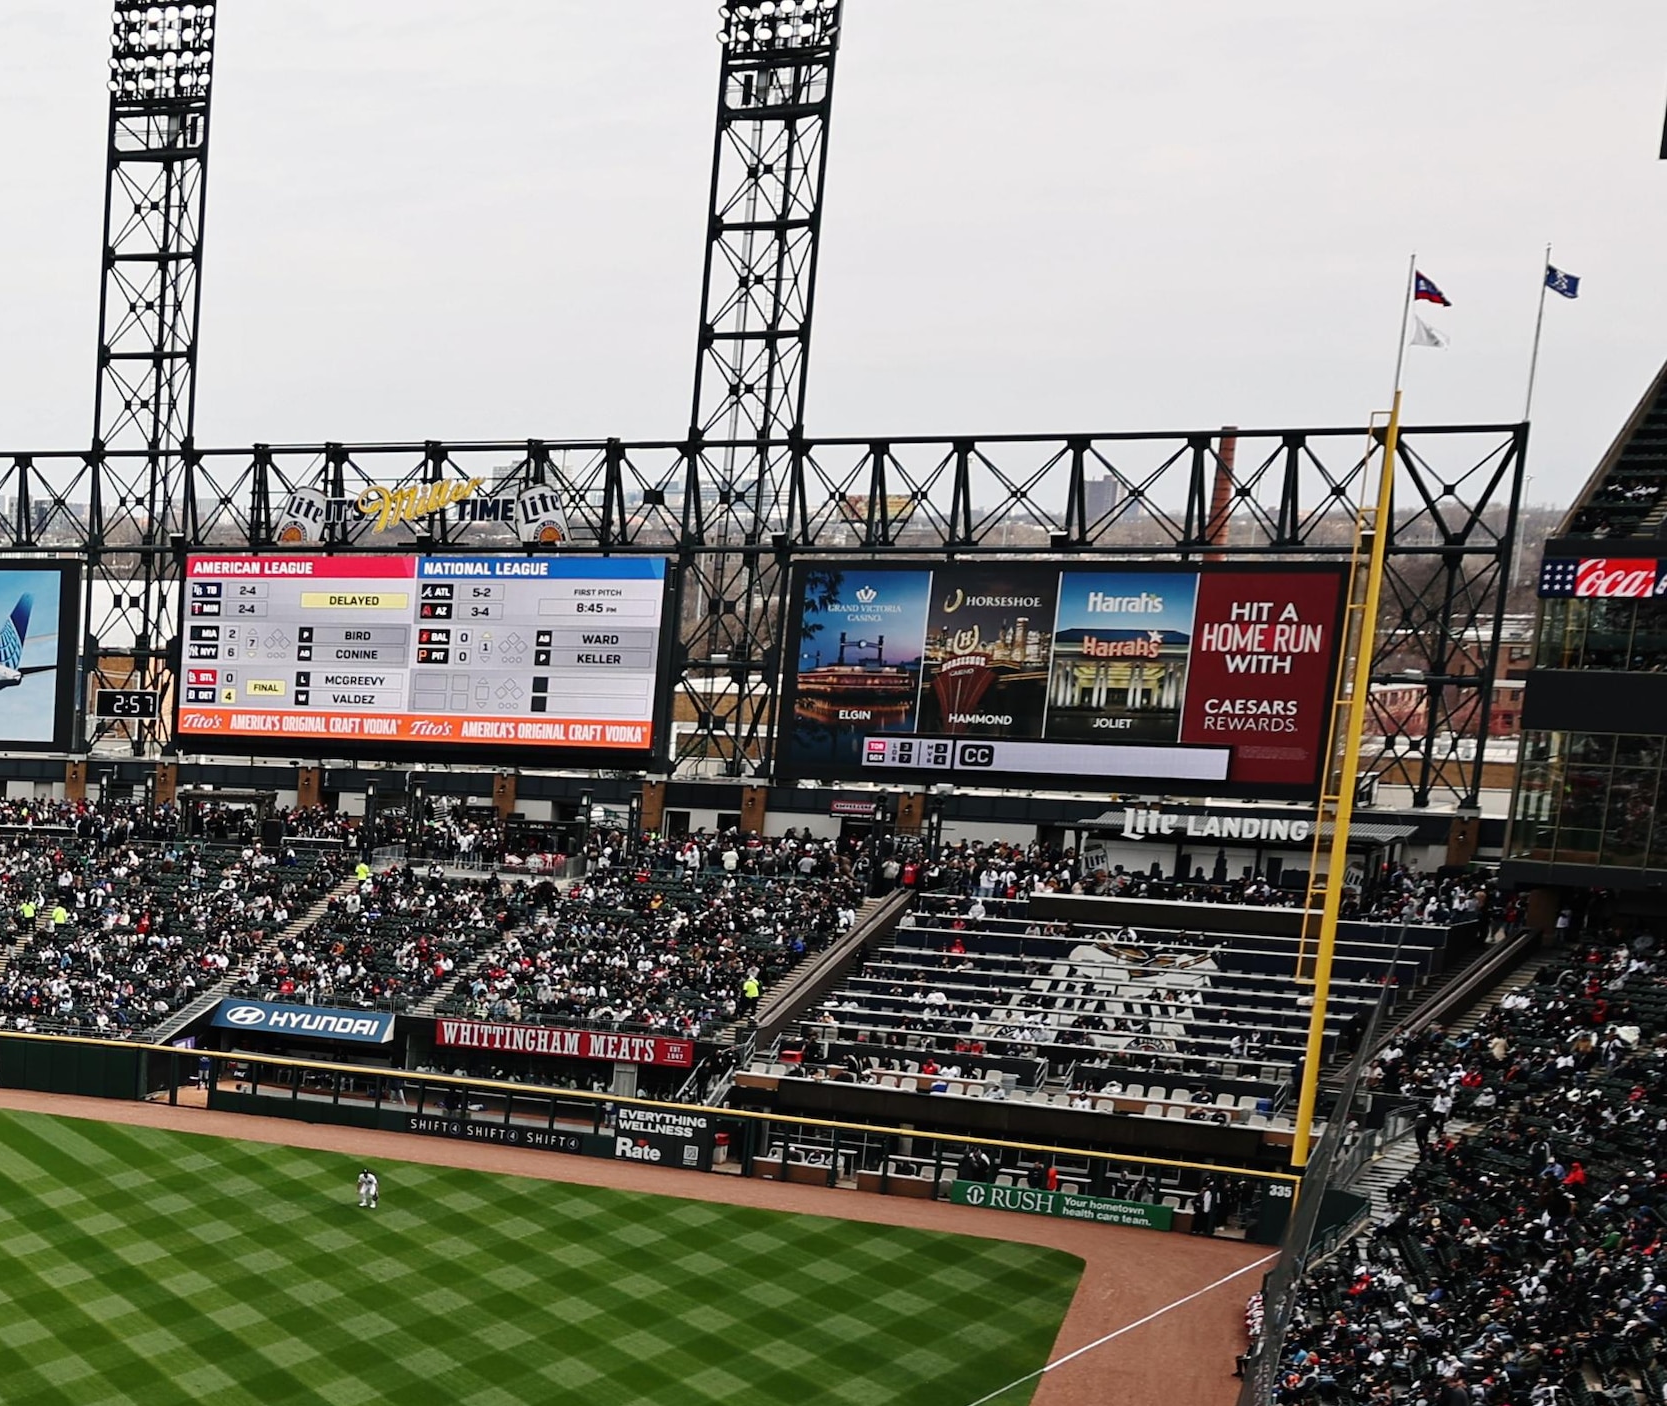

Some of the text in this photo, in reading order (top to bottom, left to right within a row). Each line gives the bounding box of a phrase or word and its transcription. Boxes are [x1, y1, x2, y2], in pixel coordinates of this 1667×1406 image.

[357, 475, 486, 535] Miller
[456, 498, 516, 521] TIME
[193, 562, 313, 574] AMERICAN LEAGUE
[424, 563, 548, 575] NATIONAL LEAGUE
[329, 596, 379, 606] DELAYED
[966, 596, 1042, 607] HORSESHOE
[1231, 602, 1299, 622] HIT A
[345, 631, 371, 641] BIRD
[582, 635, 619, 644] WARD
[1201, 623, 1322, 653] HOME RUN
[335, 650, 378, 660] CONINE
[577, 654, 621, 664] KELLER
[1225, 654, 1292, 674] WITH
[253, 684, 279, 692] FINAL
[325, 676, 385, 686] MCGREEVY
[113, 695, 154, 713] 2:57
[333, 694, 375, 704] VALDEZ
[1205, 699, 1298, 715] CAESARS
[839, 710, 871, 720] ELGIN
[948, 713, 1012, 725] HAMMOND
[1093, 718, 1132, 729] JOLIET
[1121, 807, 1309, 842] Lite LANDING
[269, 1010, 379, 1036] HYUNDAI
[442, 1021, 655, 1063] WHITTINGHAM MEATS
[619, 1109, 707, 1128] EVERYTHING
[618, 1119, 693, 1138] WELLNESS
[616, 1137, 661, 1162] Rate
[1269, 1184, 1292, 1198] 335
[990, 1187, 1053, 1214] RUSH
[1063, 1196, 1145, 1215] Your hometown
[1062, 1206, 1151, 1226] health care team.
